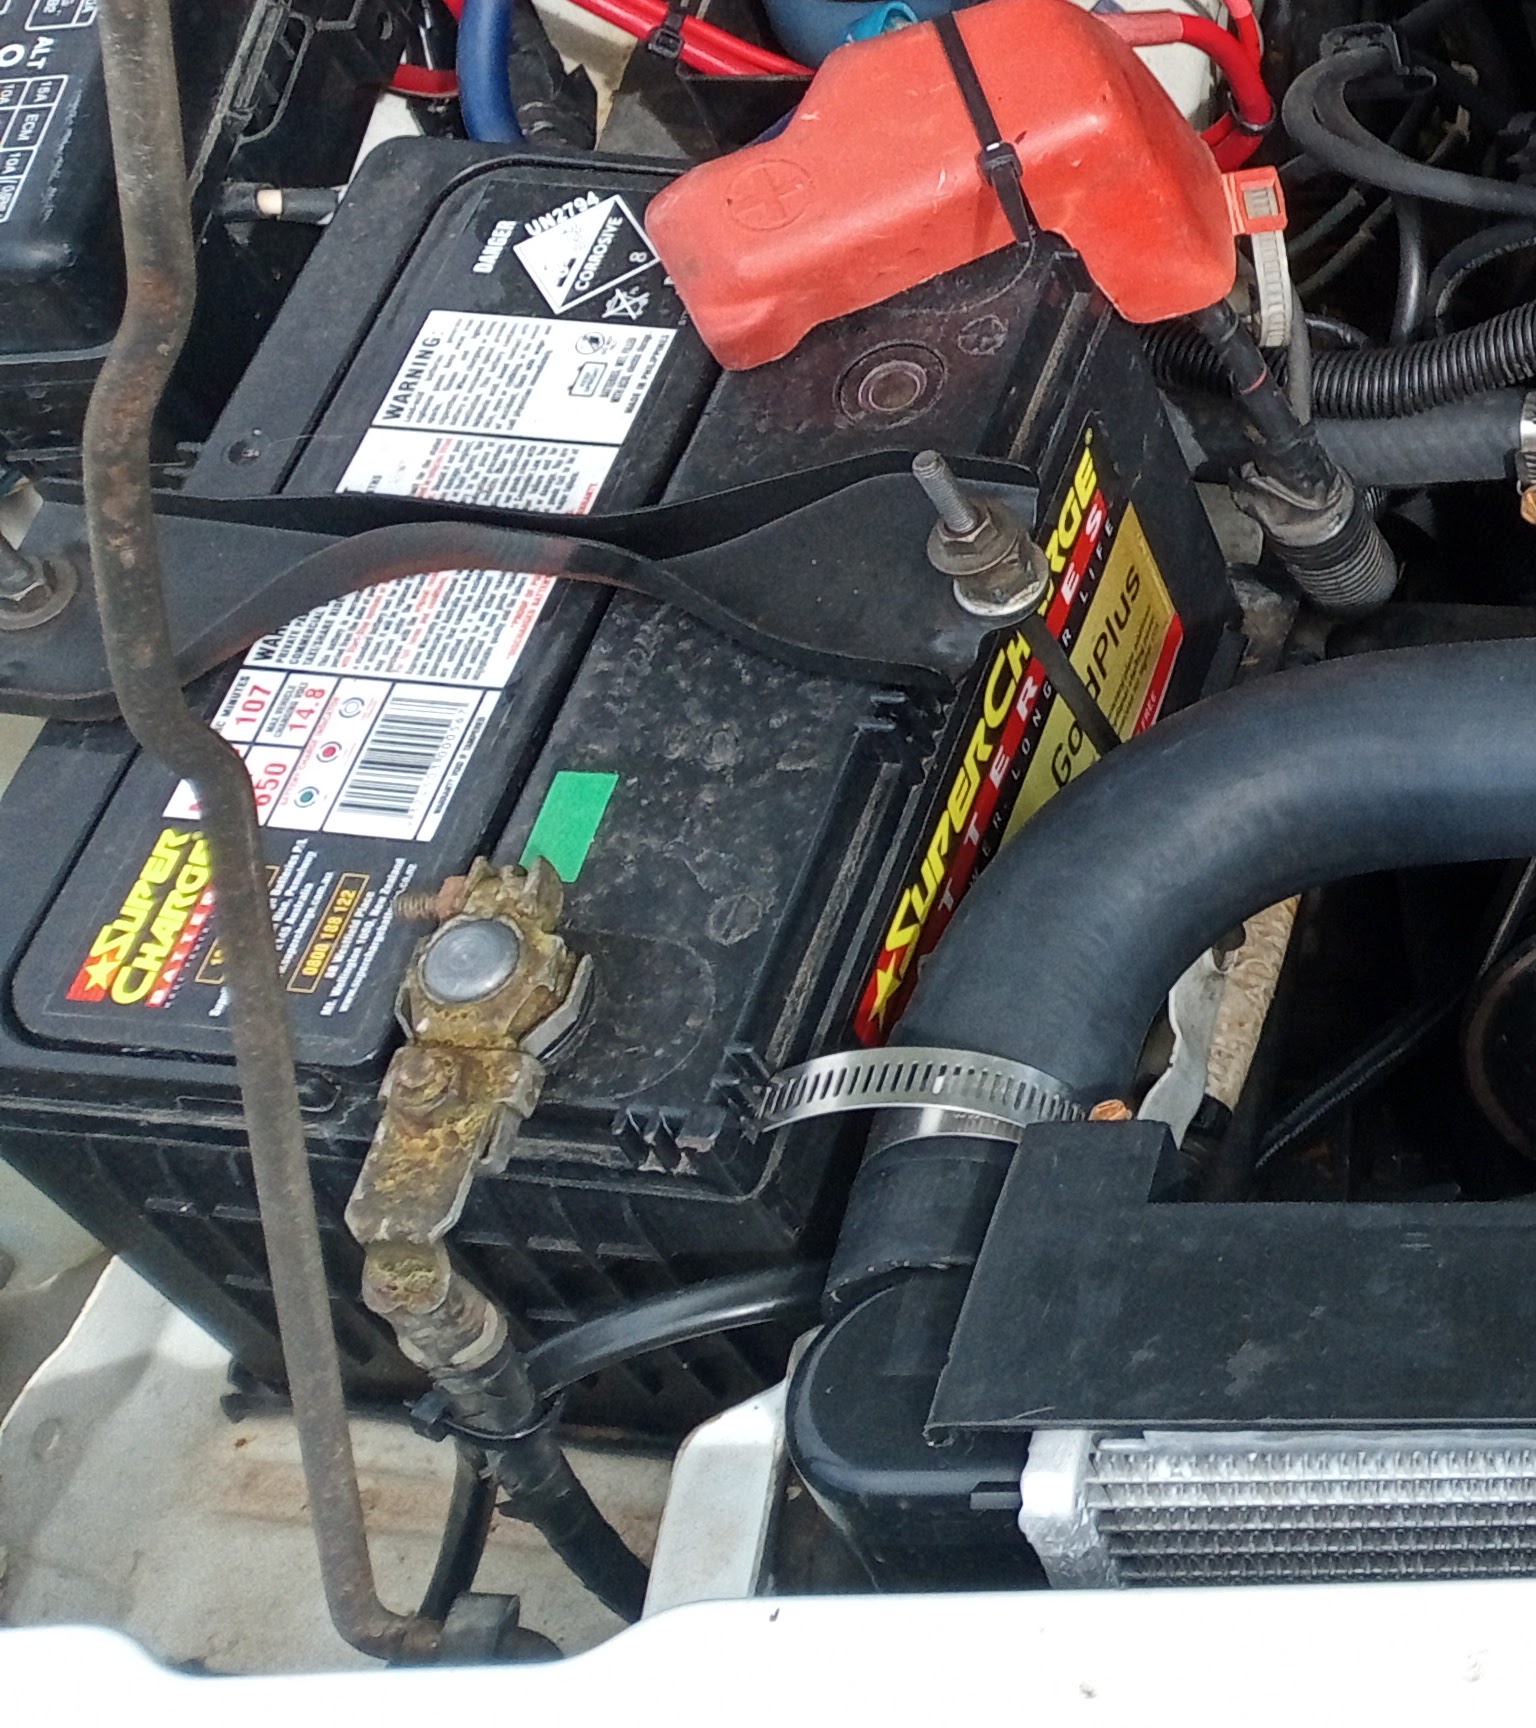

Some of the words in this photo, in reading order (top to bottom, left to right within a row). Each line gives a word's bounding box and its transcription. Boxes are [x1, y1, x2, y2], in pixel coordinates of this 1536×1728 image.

[26, 36, 54, 69] ALT
[17, 114, 38, 141] ECM
[525, 191, 600, 237] UN2794
[472, 220, 518, 274] DANGER
[574, 216, 624, 292] CORROSIVE
[629, 251, 648, 263] 8
[623, 392, 642, 413] MADE
[274, 629, 302, 663] PRIVATE
[287, 610, 326, 664] COMMERCIAL
[300, 619, 336, 665] TAXI/SHARE
[1010, 627, 1073, 781] LONGR
[1079, 518, 1115, 606] LIFE
[223, 675, 251, 716] MINUTES
[235, 685, 273, 726] 107
[272, 684, 297, 714] VEHICLE
[288, 688, 326, 731] 14.8
[271, 700, 300, 737] CHARGING
[255, 762, 288, 805] 650
[101, 829, 191, 957] SUPER
[269, 853, 301, 895] Batteries
[376, 857, 408, 894] Zealand
[111, 837, 212, 1003] CHARGE
[283, 882, 315, 923] Australia
[367, 895, 388, 916] New
[305, 942, 332, 975] 0800
[333, 889, 359, 912] 122
[329, 919, 364, 963] Westfield
[353, 890, 377, 917] Place
[326, 946, 366, 997] Wellington
